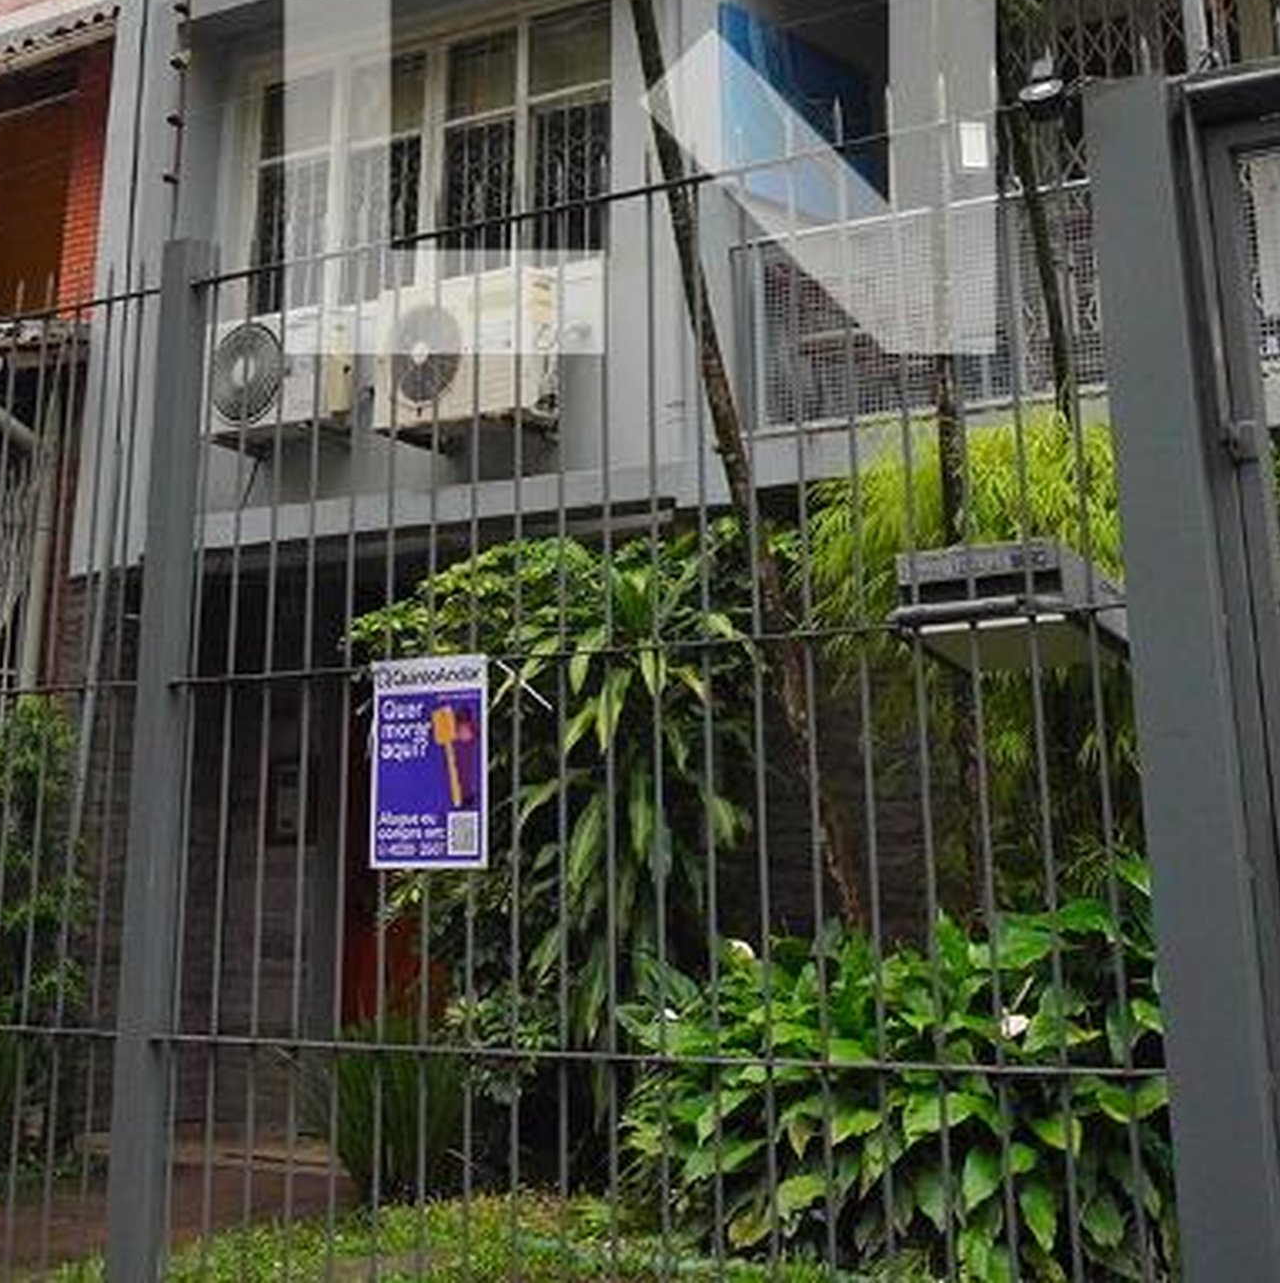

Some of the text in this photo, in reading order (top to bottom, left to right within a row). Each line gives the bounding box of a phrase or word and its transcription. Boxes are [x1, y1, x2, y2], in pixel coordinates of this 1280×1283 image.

[381, 701, 423, 719] Quer
[381, 723, 431, 739] morar
[381, 738, 429, 761] aqui?
